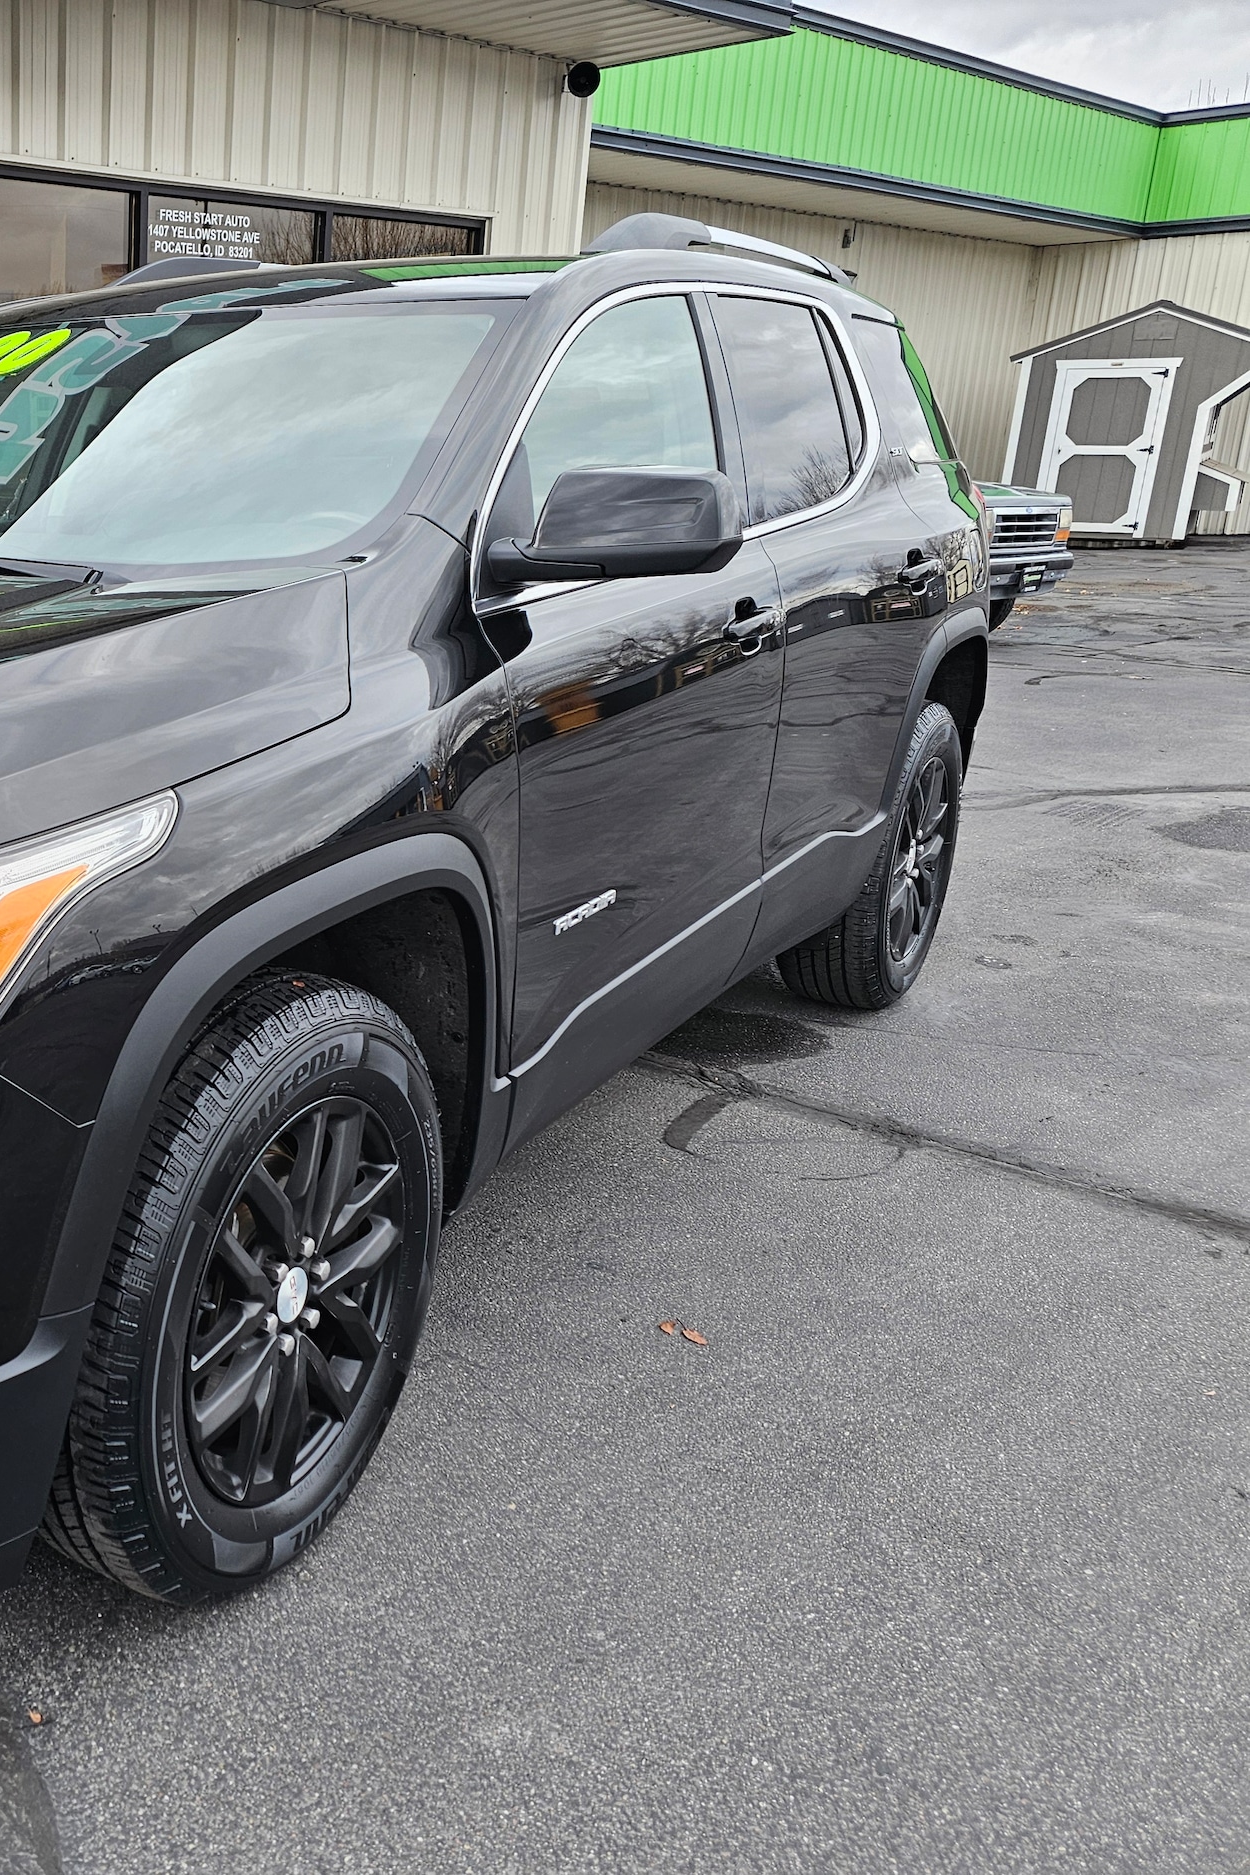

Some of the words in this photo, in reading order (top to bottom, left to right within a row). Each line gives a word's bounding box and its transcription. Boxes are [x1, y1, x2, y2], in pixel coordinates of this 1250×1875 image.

[159, 209, 191, 224] FRESH
[193, 212, 223, 226] START
[224, 215, 250, 228] AUTO
[148, 224, 169, 237] 1407
[171, 227, 241, 243] YELLOWSTONE
[242, 232, 260, 244] AVE
[154, 240, 213, 258] POCATELLO,
[215, 245, 224, 257] ID
[228, 246, 253, 259] 83201
[163, 1461, 183, 1504] FIT
[175, 1502, 193, 1529] X
